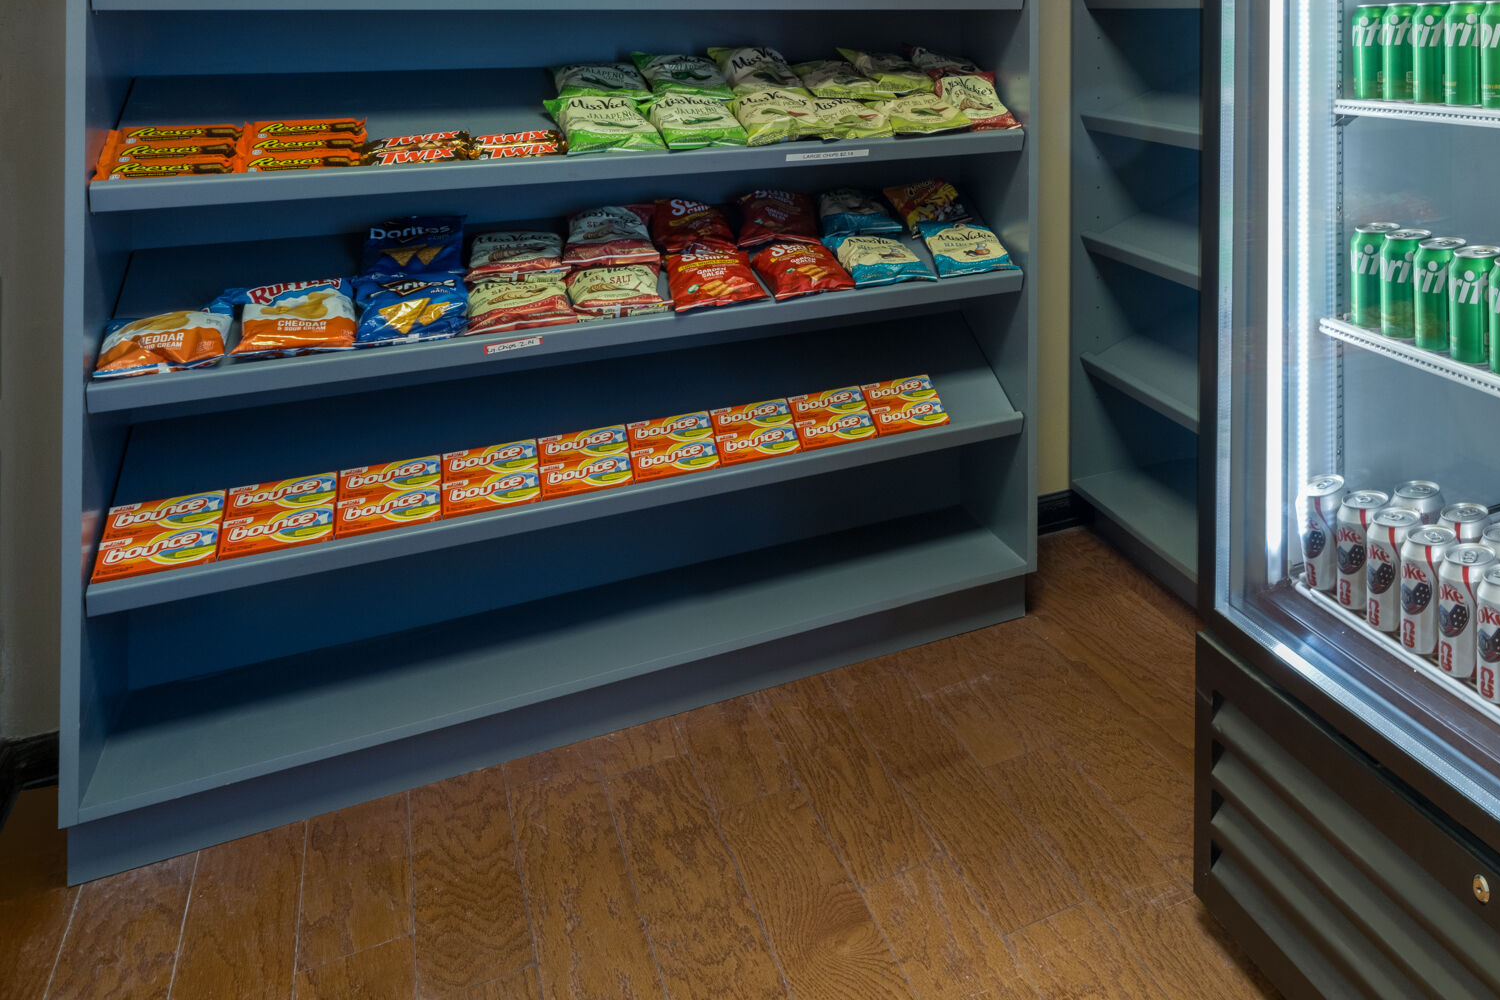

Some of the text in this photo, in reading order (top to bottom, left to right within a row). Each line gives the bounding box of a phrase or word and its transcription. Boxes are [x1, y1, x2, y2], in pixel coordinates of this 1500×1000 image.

[568, 98, 629, 110] Miss Vick
[370, 226, 451, 240] Doritos
[609, 275, 633, 285] SALT
[277, 319, 327, 328] CHEDDAR
[139, 332, 185, 345] HEDDAR
[157, 341, 183, 349] CREAM
[1336, 527, 1362, 545] oke
[1367, 546, 1390, 563] oke
[1401, 563, 1427, 583] oke
[1439, 584, 1465, 605] oke
